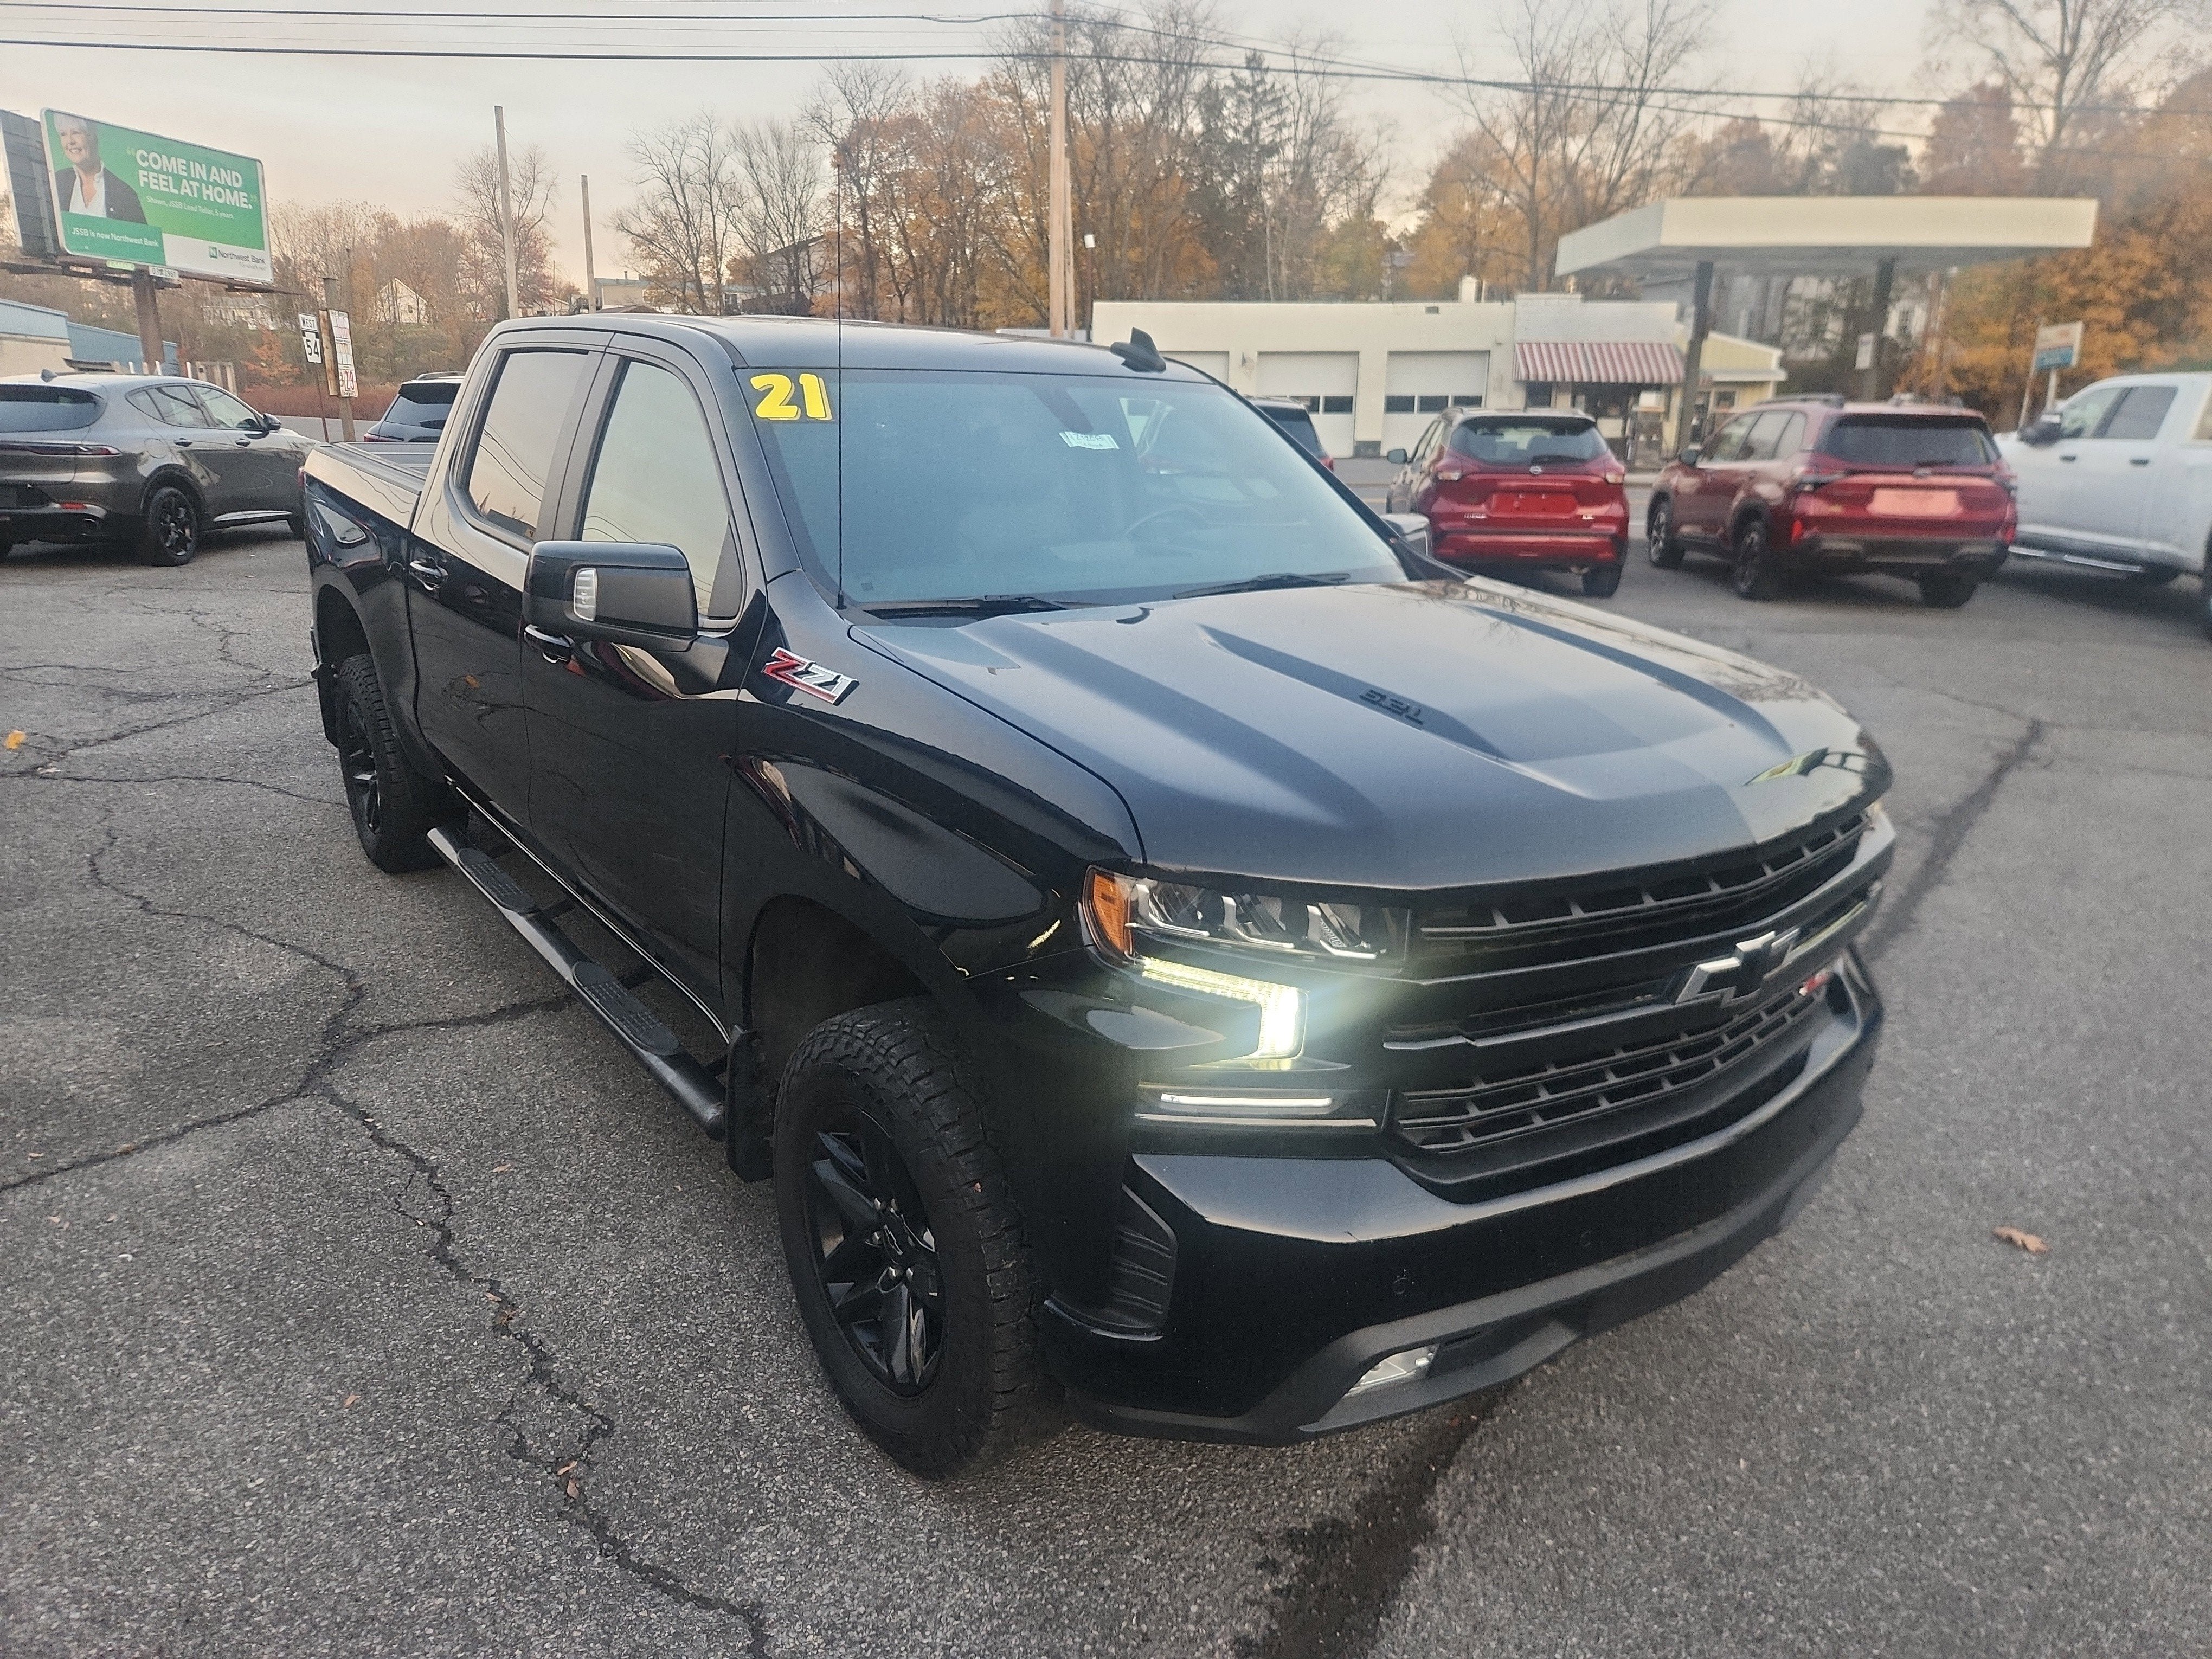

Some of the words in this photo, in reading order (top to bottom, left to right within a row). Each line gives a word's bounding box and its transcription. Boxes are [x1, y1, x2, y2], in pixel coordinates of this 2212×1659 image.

[138, 169, 179, 194] FEEL
[180, 179, 200, 198] AT
[189, 160, 207, 181] IN
[209, 166, 243, 188] AND
[169, 198, 183, 209] JSSB
[72, 227, 88, 236] JSSB
[111, 233, 143, 245] Northwest
[143, 237, 159, 247] Bank
[218, 249, 250, 262] Northwest
[250, 255, 266, 265] Bank
[301, 317, 316, 329] WEST
[306, 339, 319, 357] 54
[750, 373, 832, 421] 21
[762, 646, 860, 706] Z71
